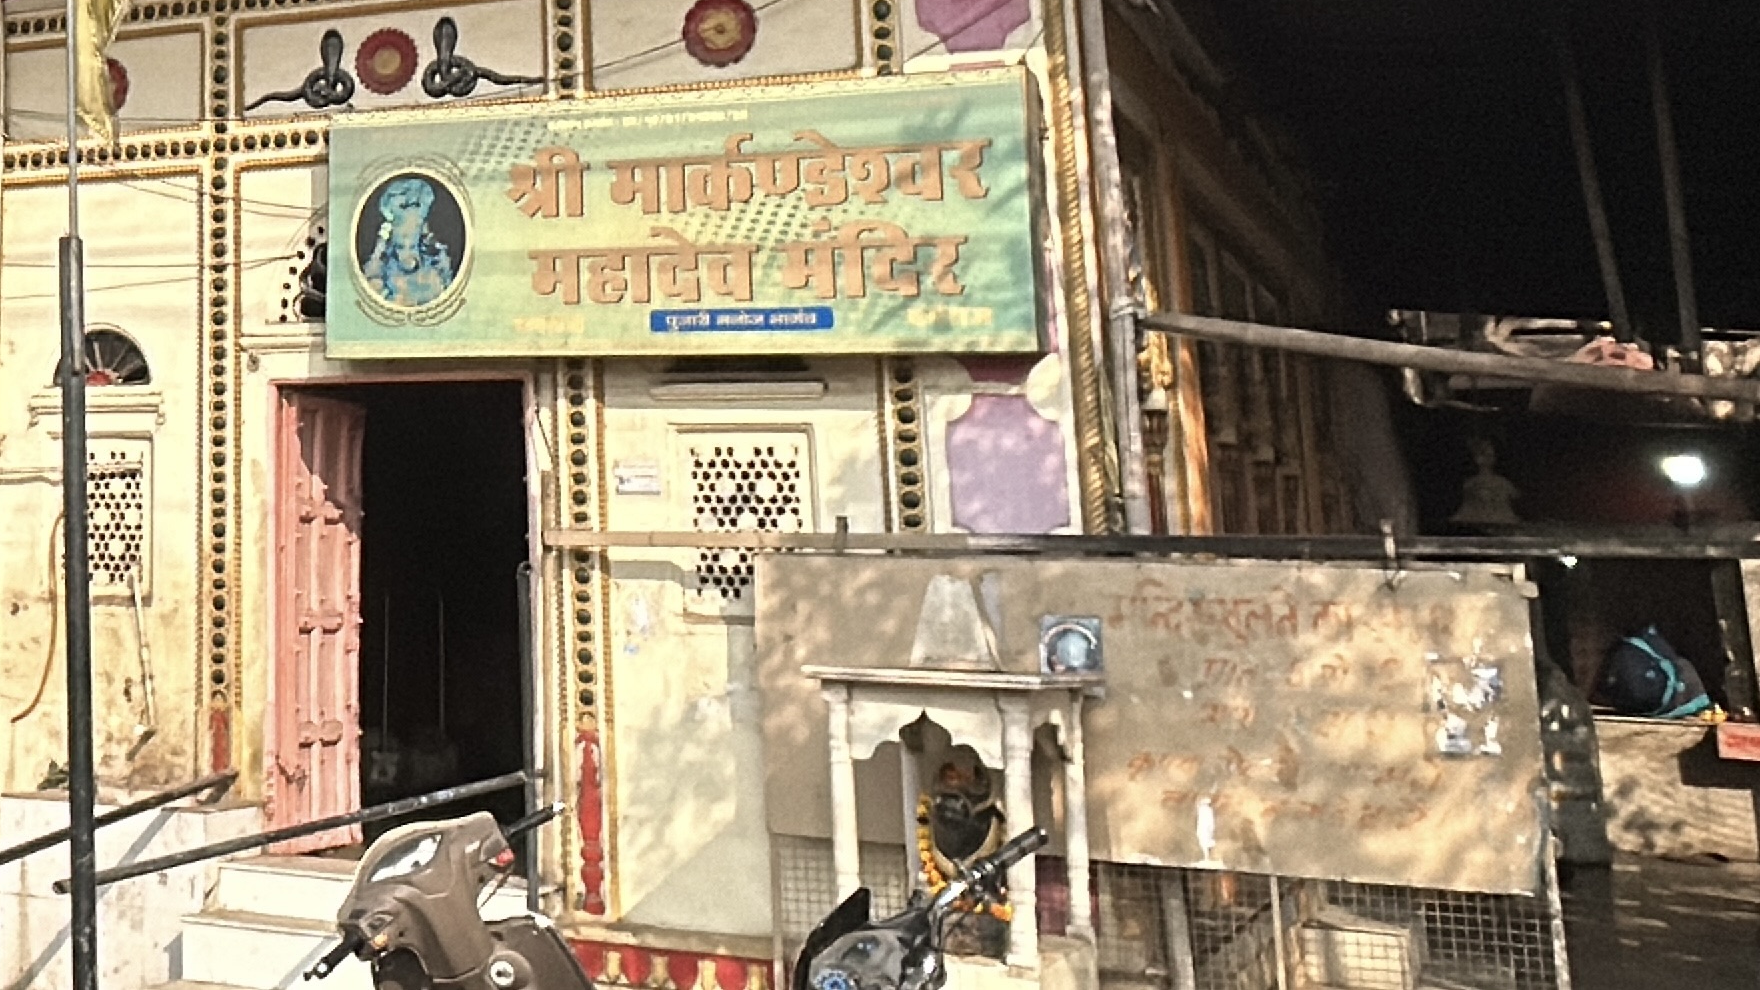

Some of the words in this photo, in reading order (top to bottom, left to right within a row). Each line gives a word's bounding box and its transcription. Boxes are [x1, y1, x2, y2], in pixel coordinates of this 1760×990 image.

[505, 145, 590, 218] श्री
[606, 128, 993, 215] मार्कण्डेश्वर
[527, 226, 760, 305] महादेव
[770, 218, 968, 299] मंदिर
